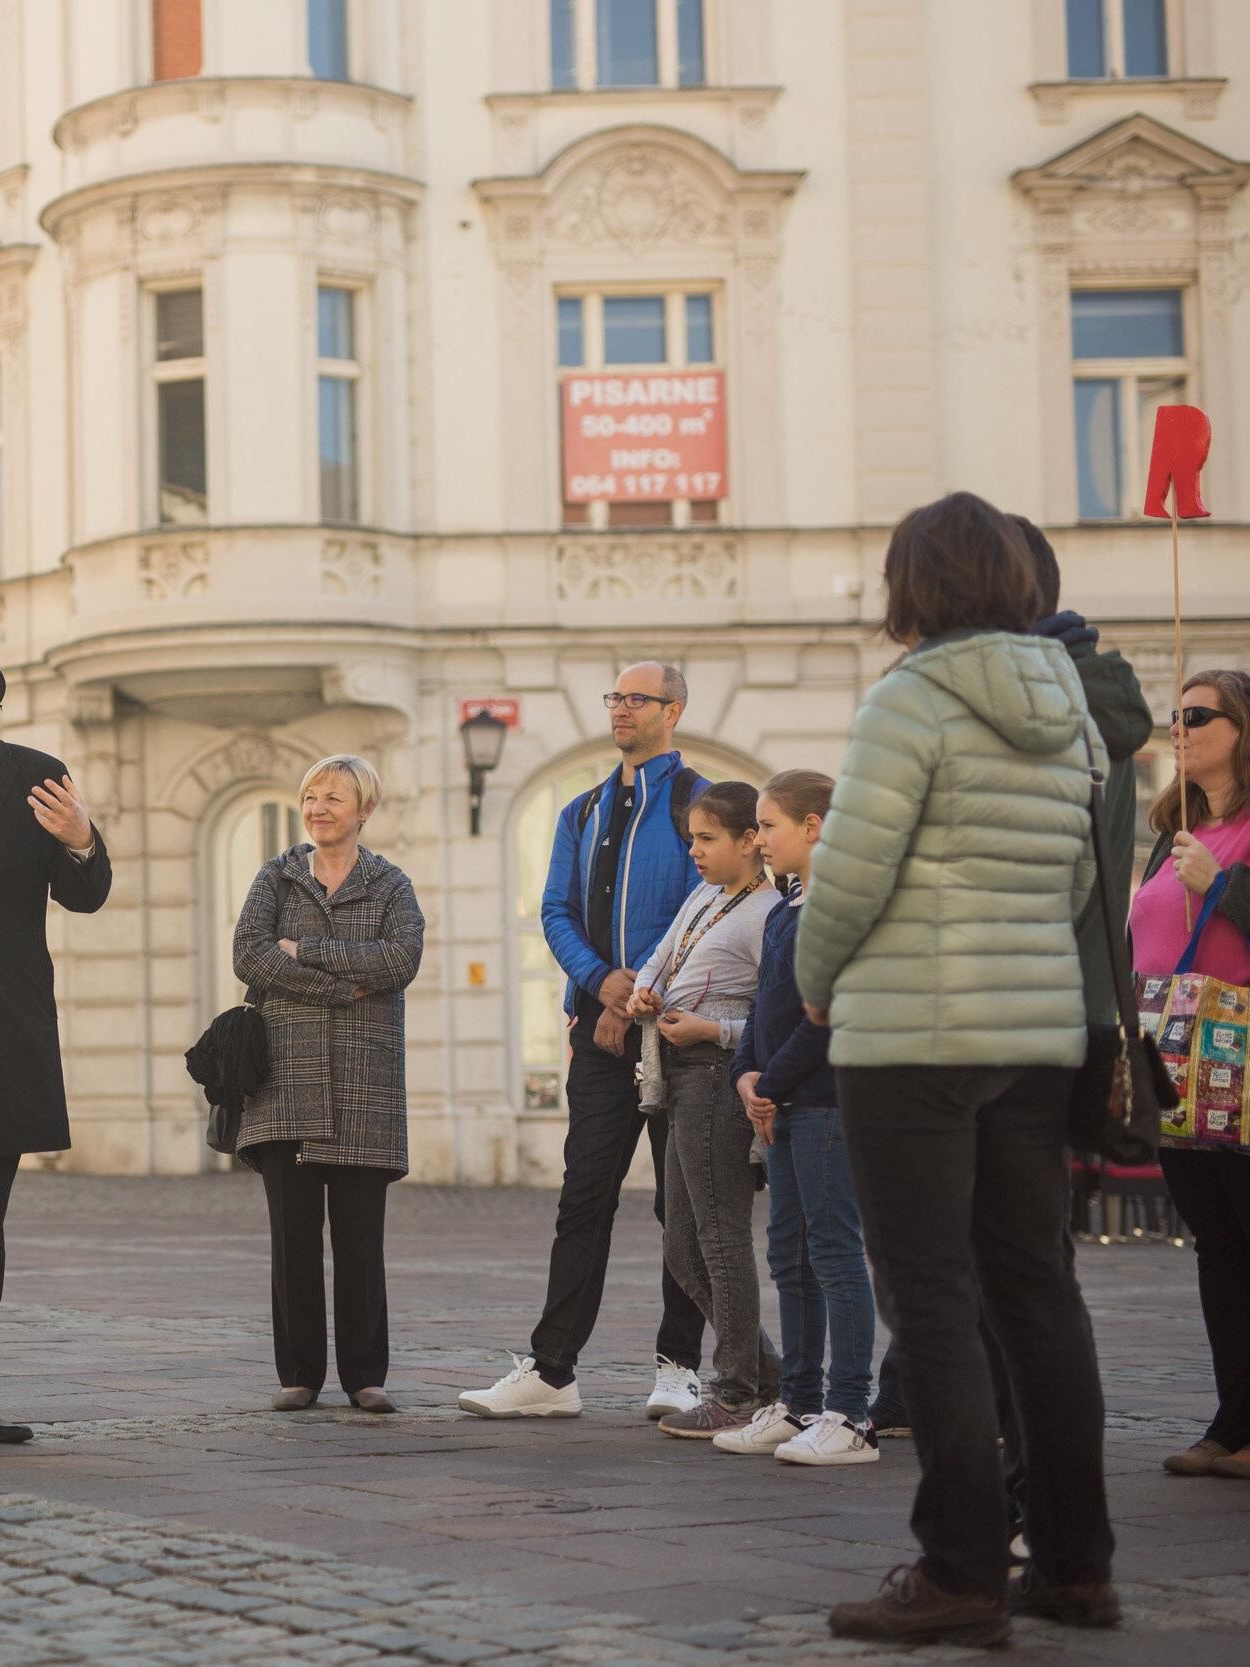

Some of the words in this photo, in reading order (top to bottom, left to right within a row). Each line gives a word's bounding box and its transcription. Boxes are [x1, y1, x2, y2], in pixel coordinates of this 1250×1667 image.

[570, 377, 718, 406] PISARNE
[581, 412, 673, 438] 50-400
[610, 448, 681, 470] INFO:
[624, 473, 668, 495] 117
[675, 471, 721, 494] 117
